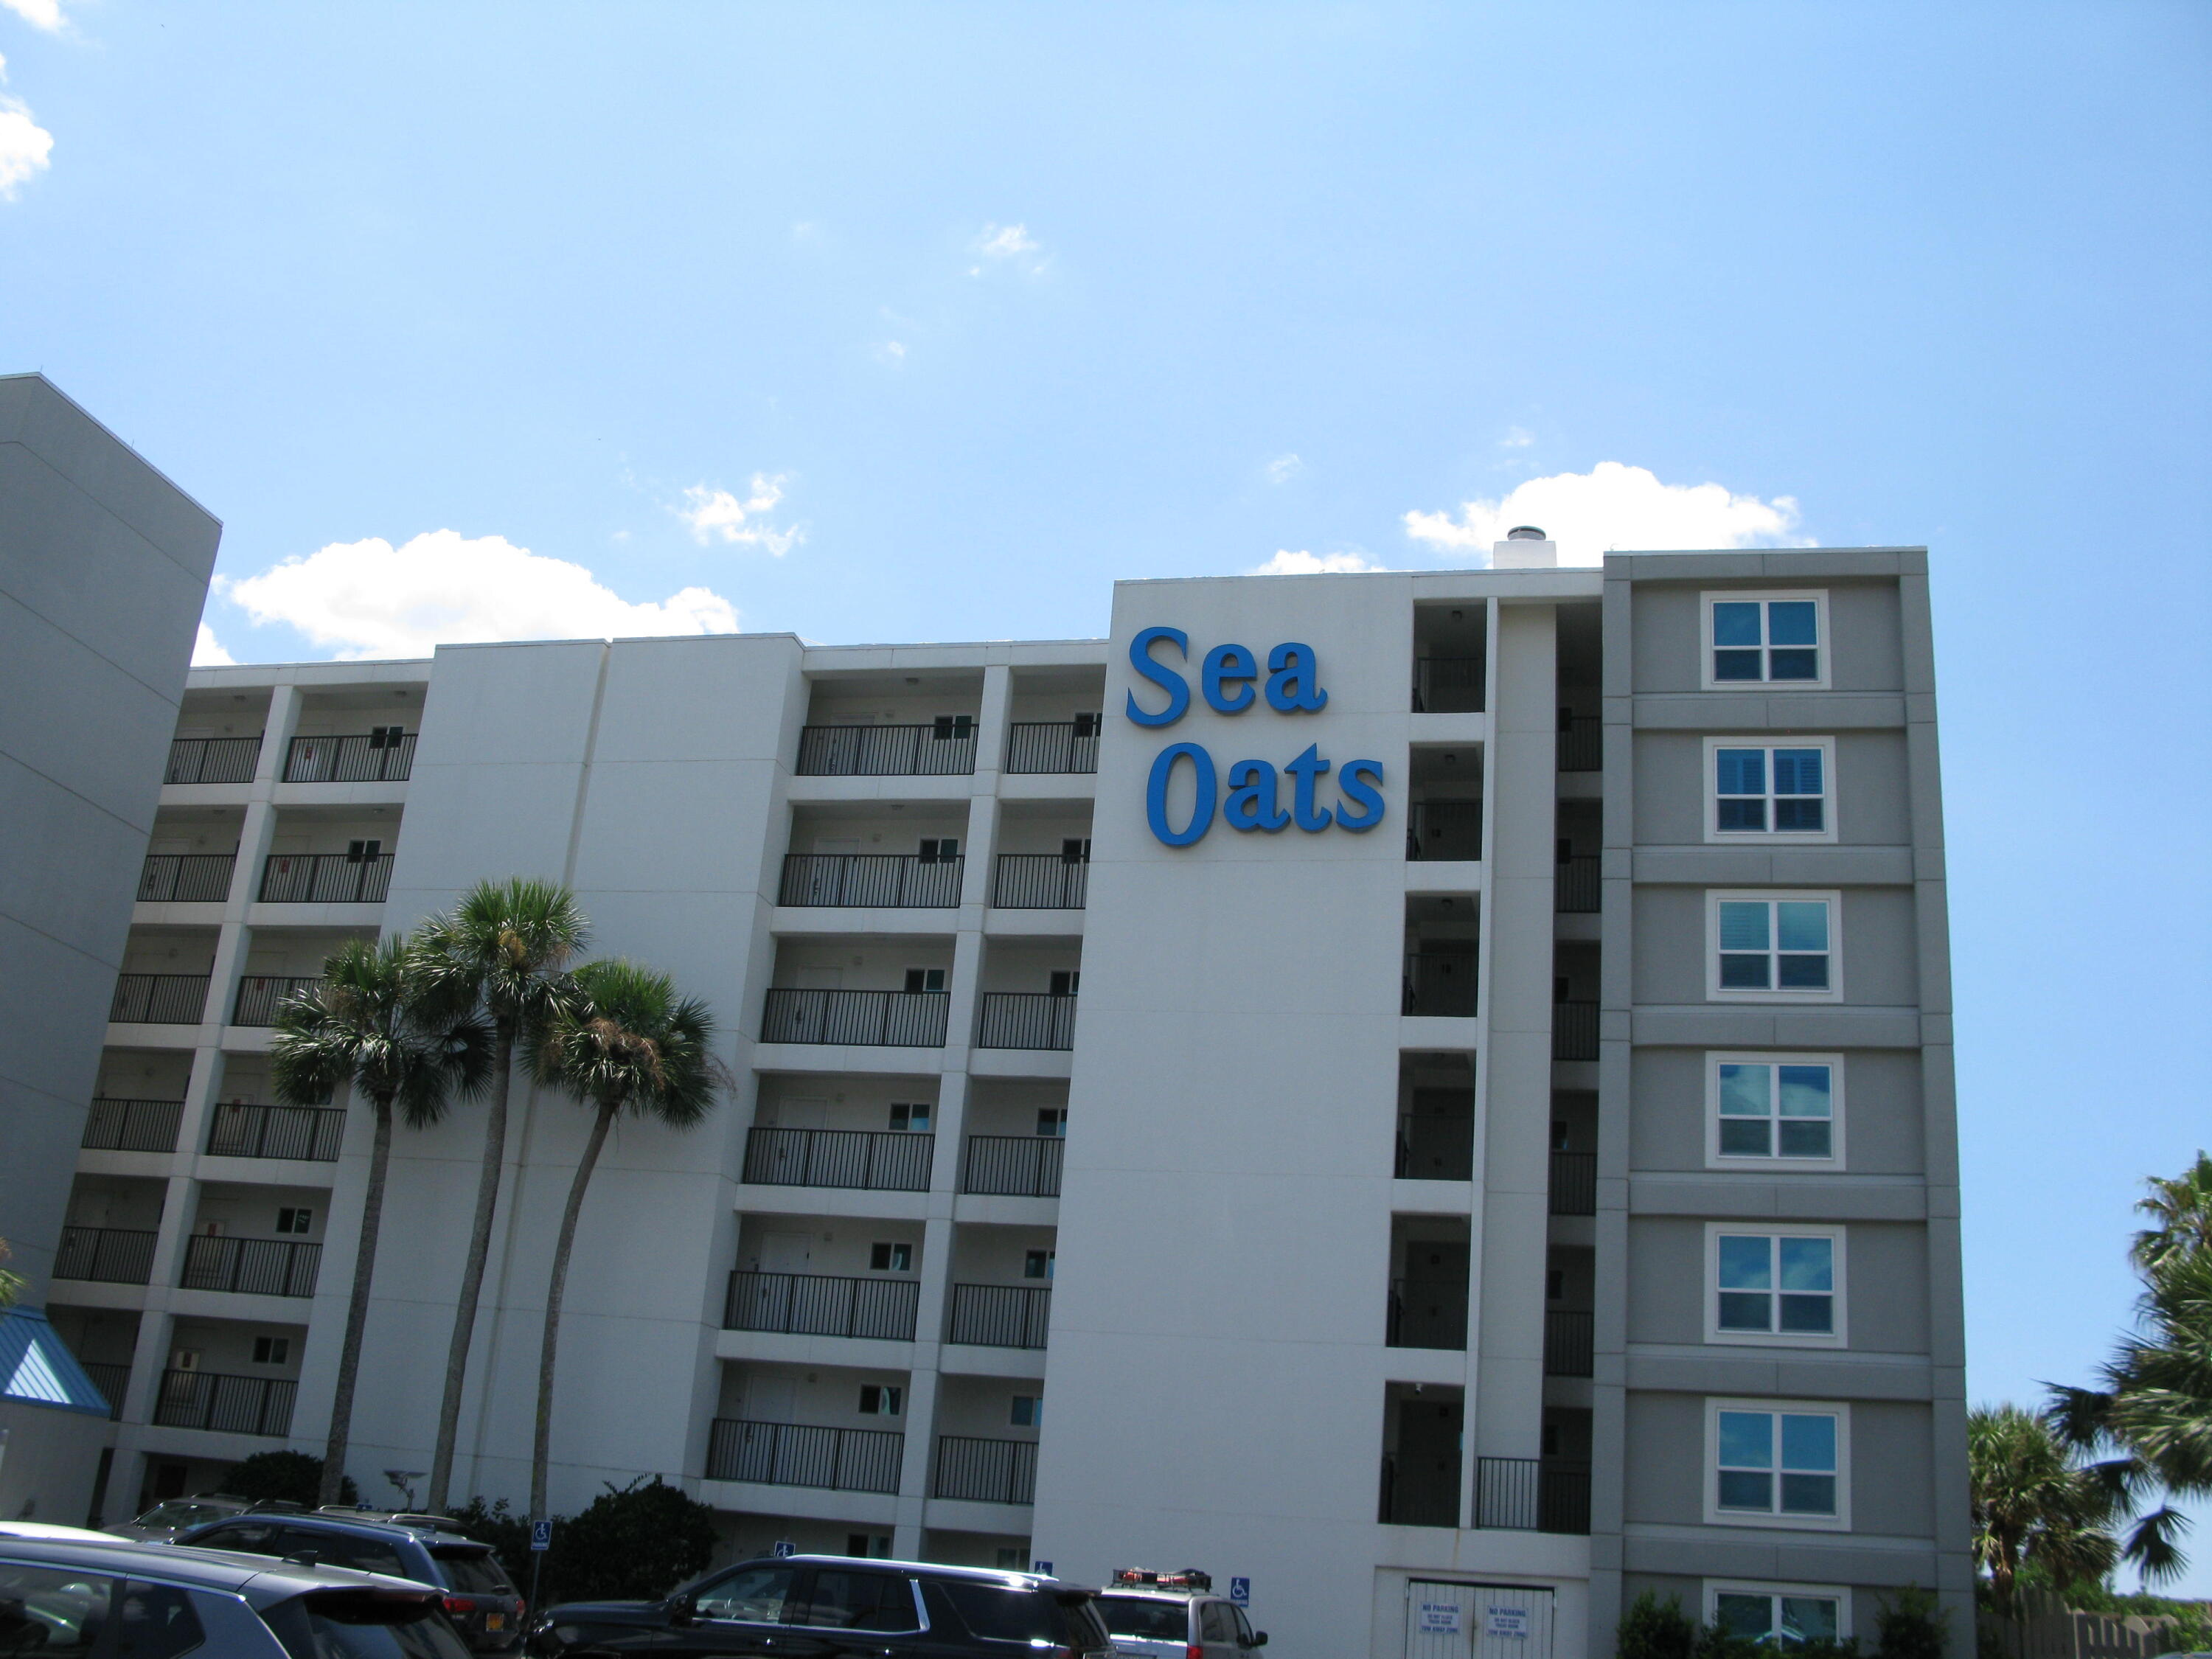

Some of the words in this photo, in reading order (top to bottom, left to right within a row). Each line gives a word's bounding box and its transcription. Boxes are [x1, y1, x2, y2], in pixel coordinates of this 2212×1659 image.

[1125, 626, 1328, 728] Sea
[1146, 742, 1385, 848] Oats
[1433, 1604, 1458, 1613] PARKING
[1500, 1608, 1526, 1617] PARKING
